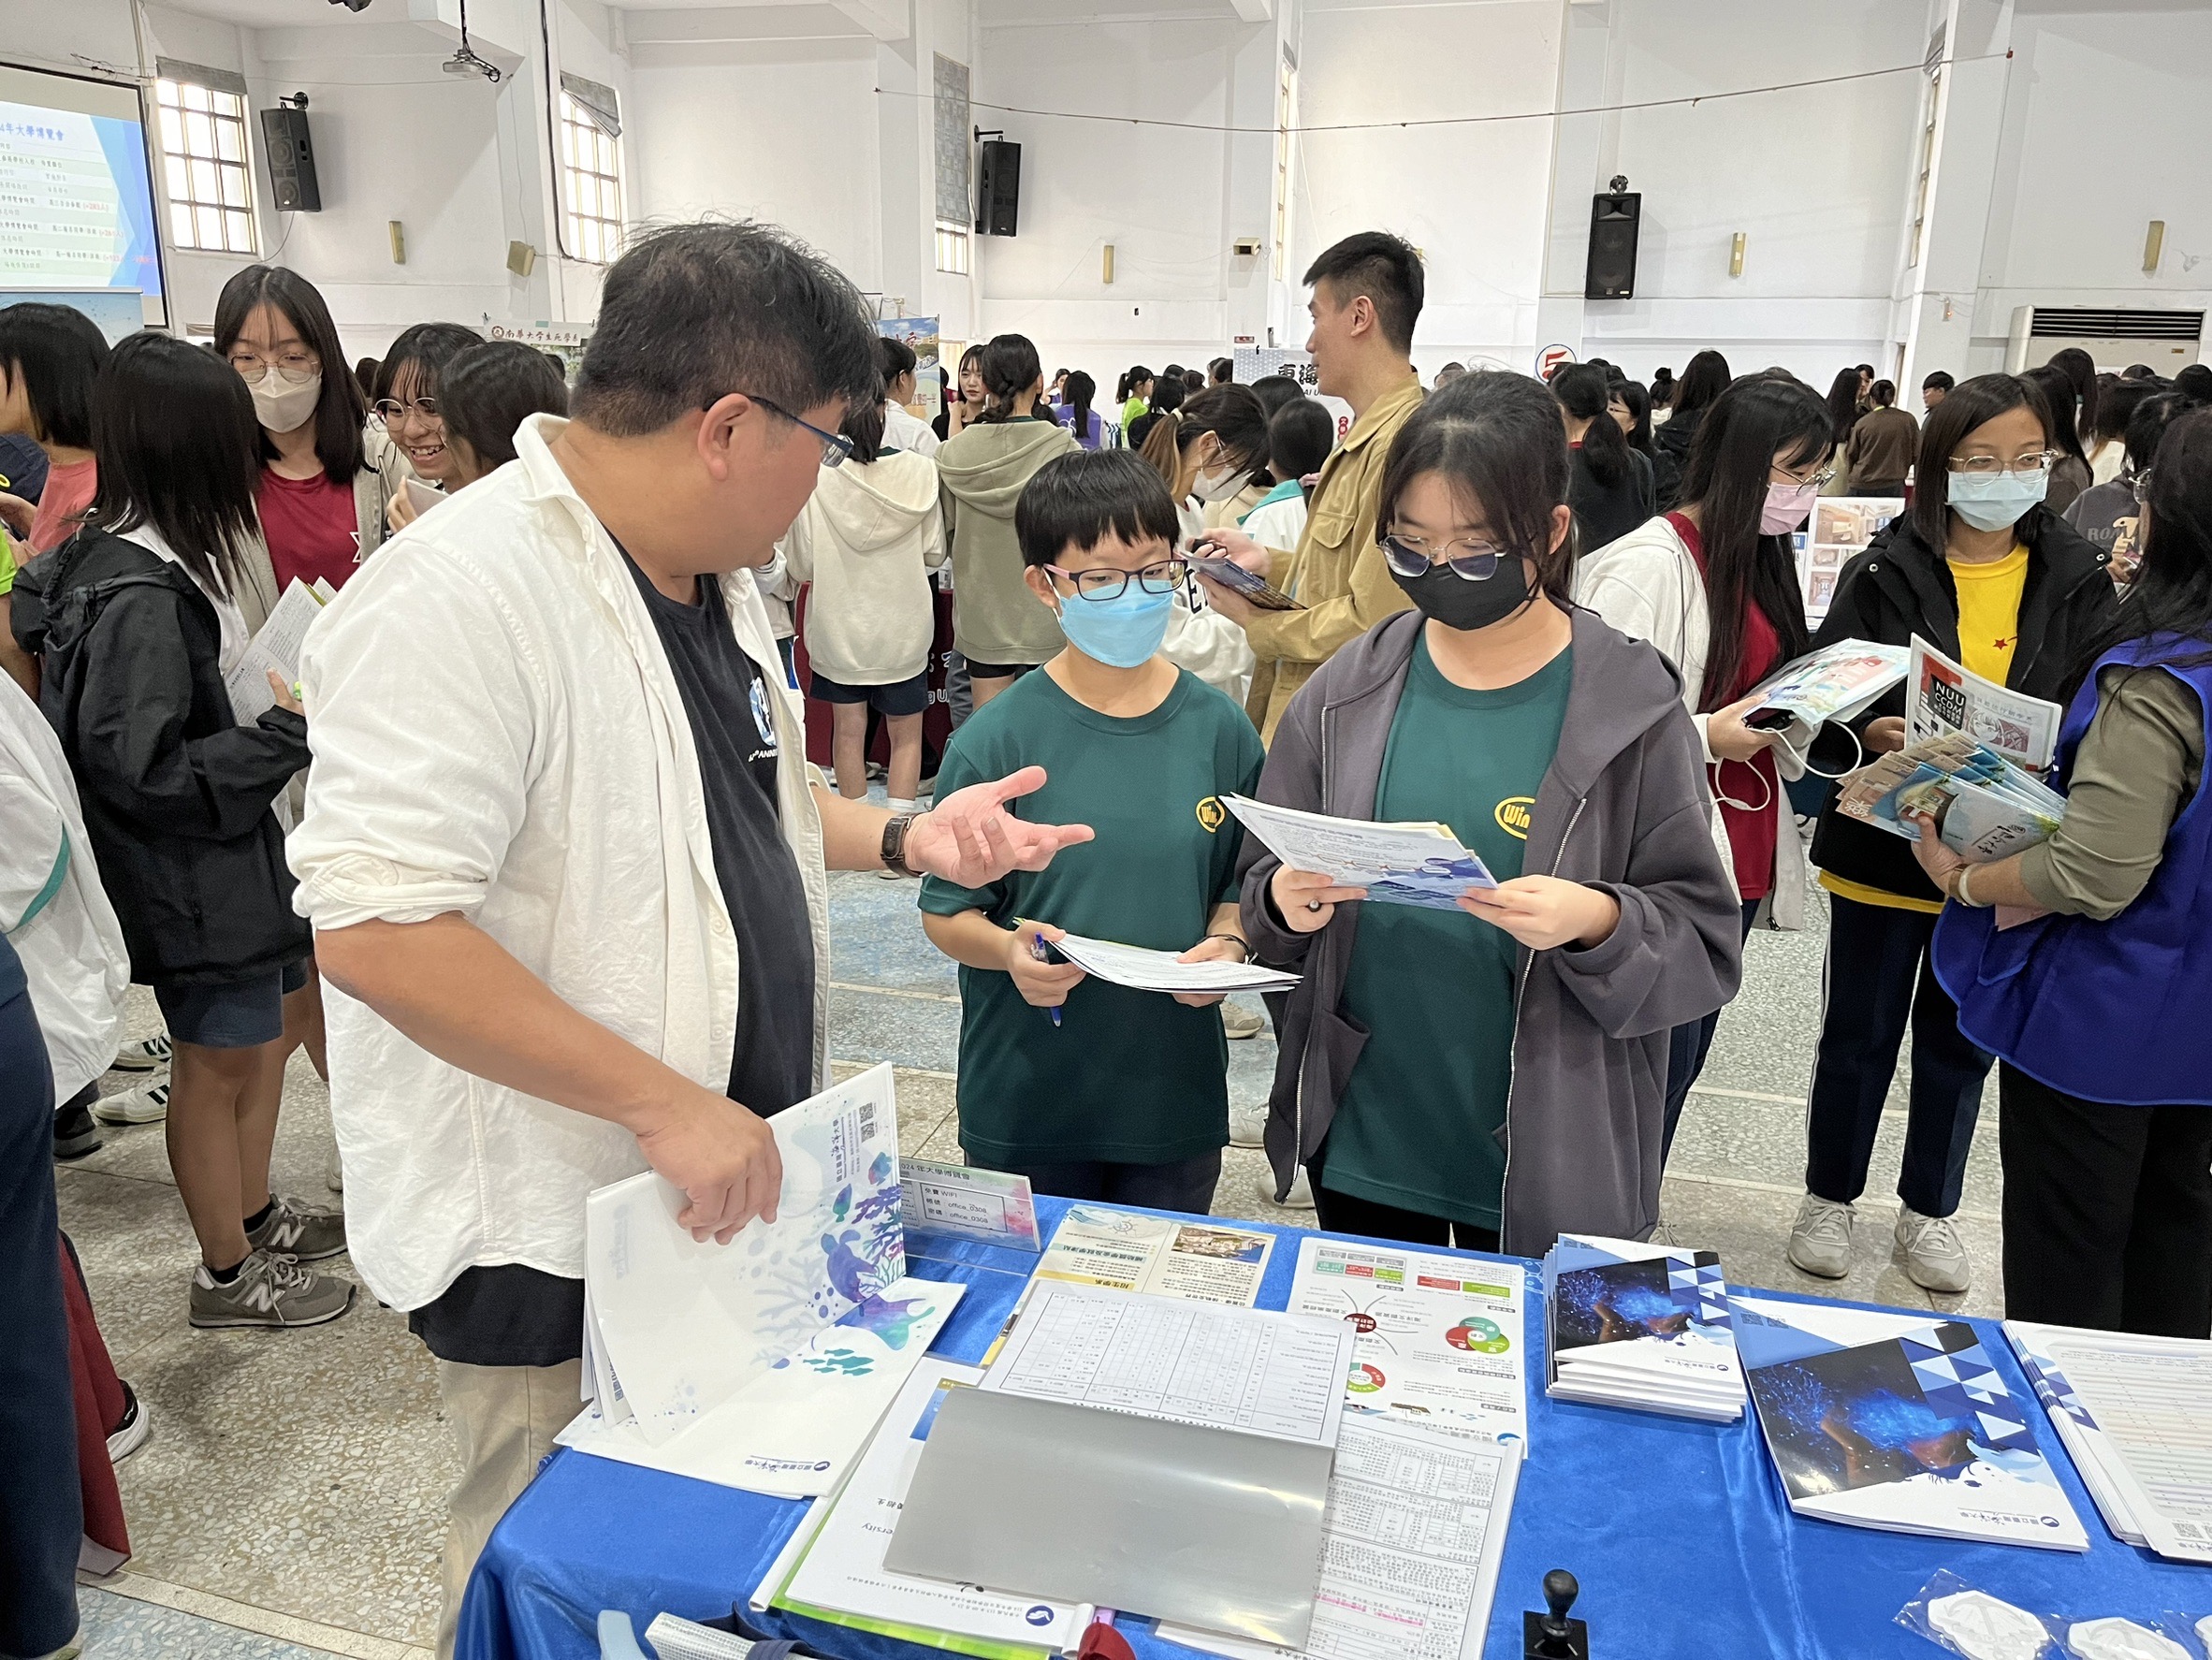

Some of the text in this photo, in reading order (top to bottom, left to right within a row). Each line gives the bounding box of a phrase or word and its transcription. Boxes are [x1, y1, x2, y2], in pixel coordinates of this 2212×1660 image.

[1935, 692, 1962, 716] CCDM
[1936, 681, 1965, 706] NUU
[861, 1522, 894, 1535] ersity
